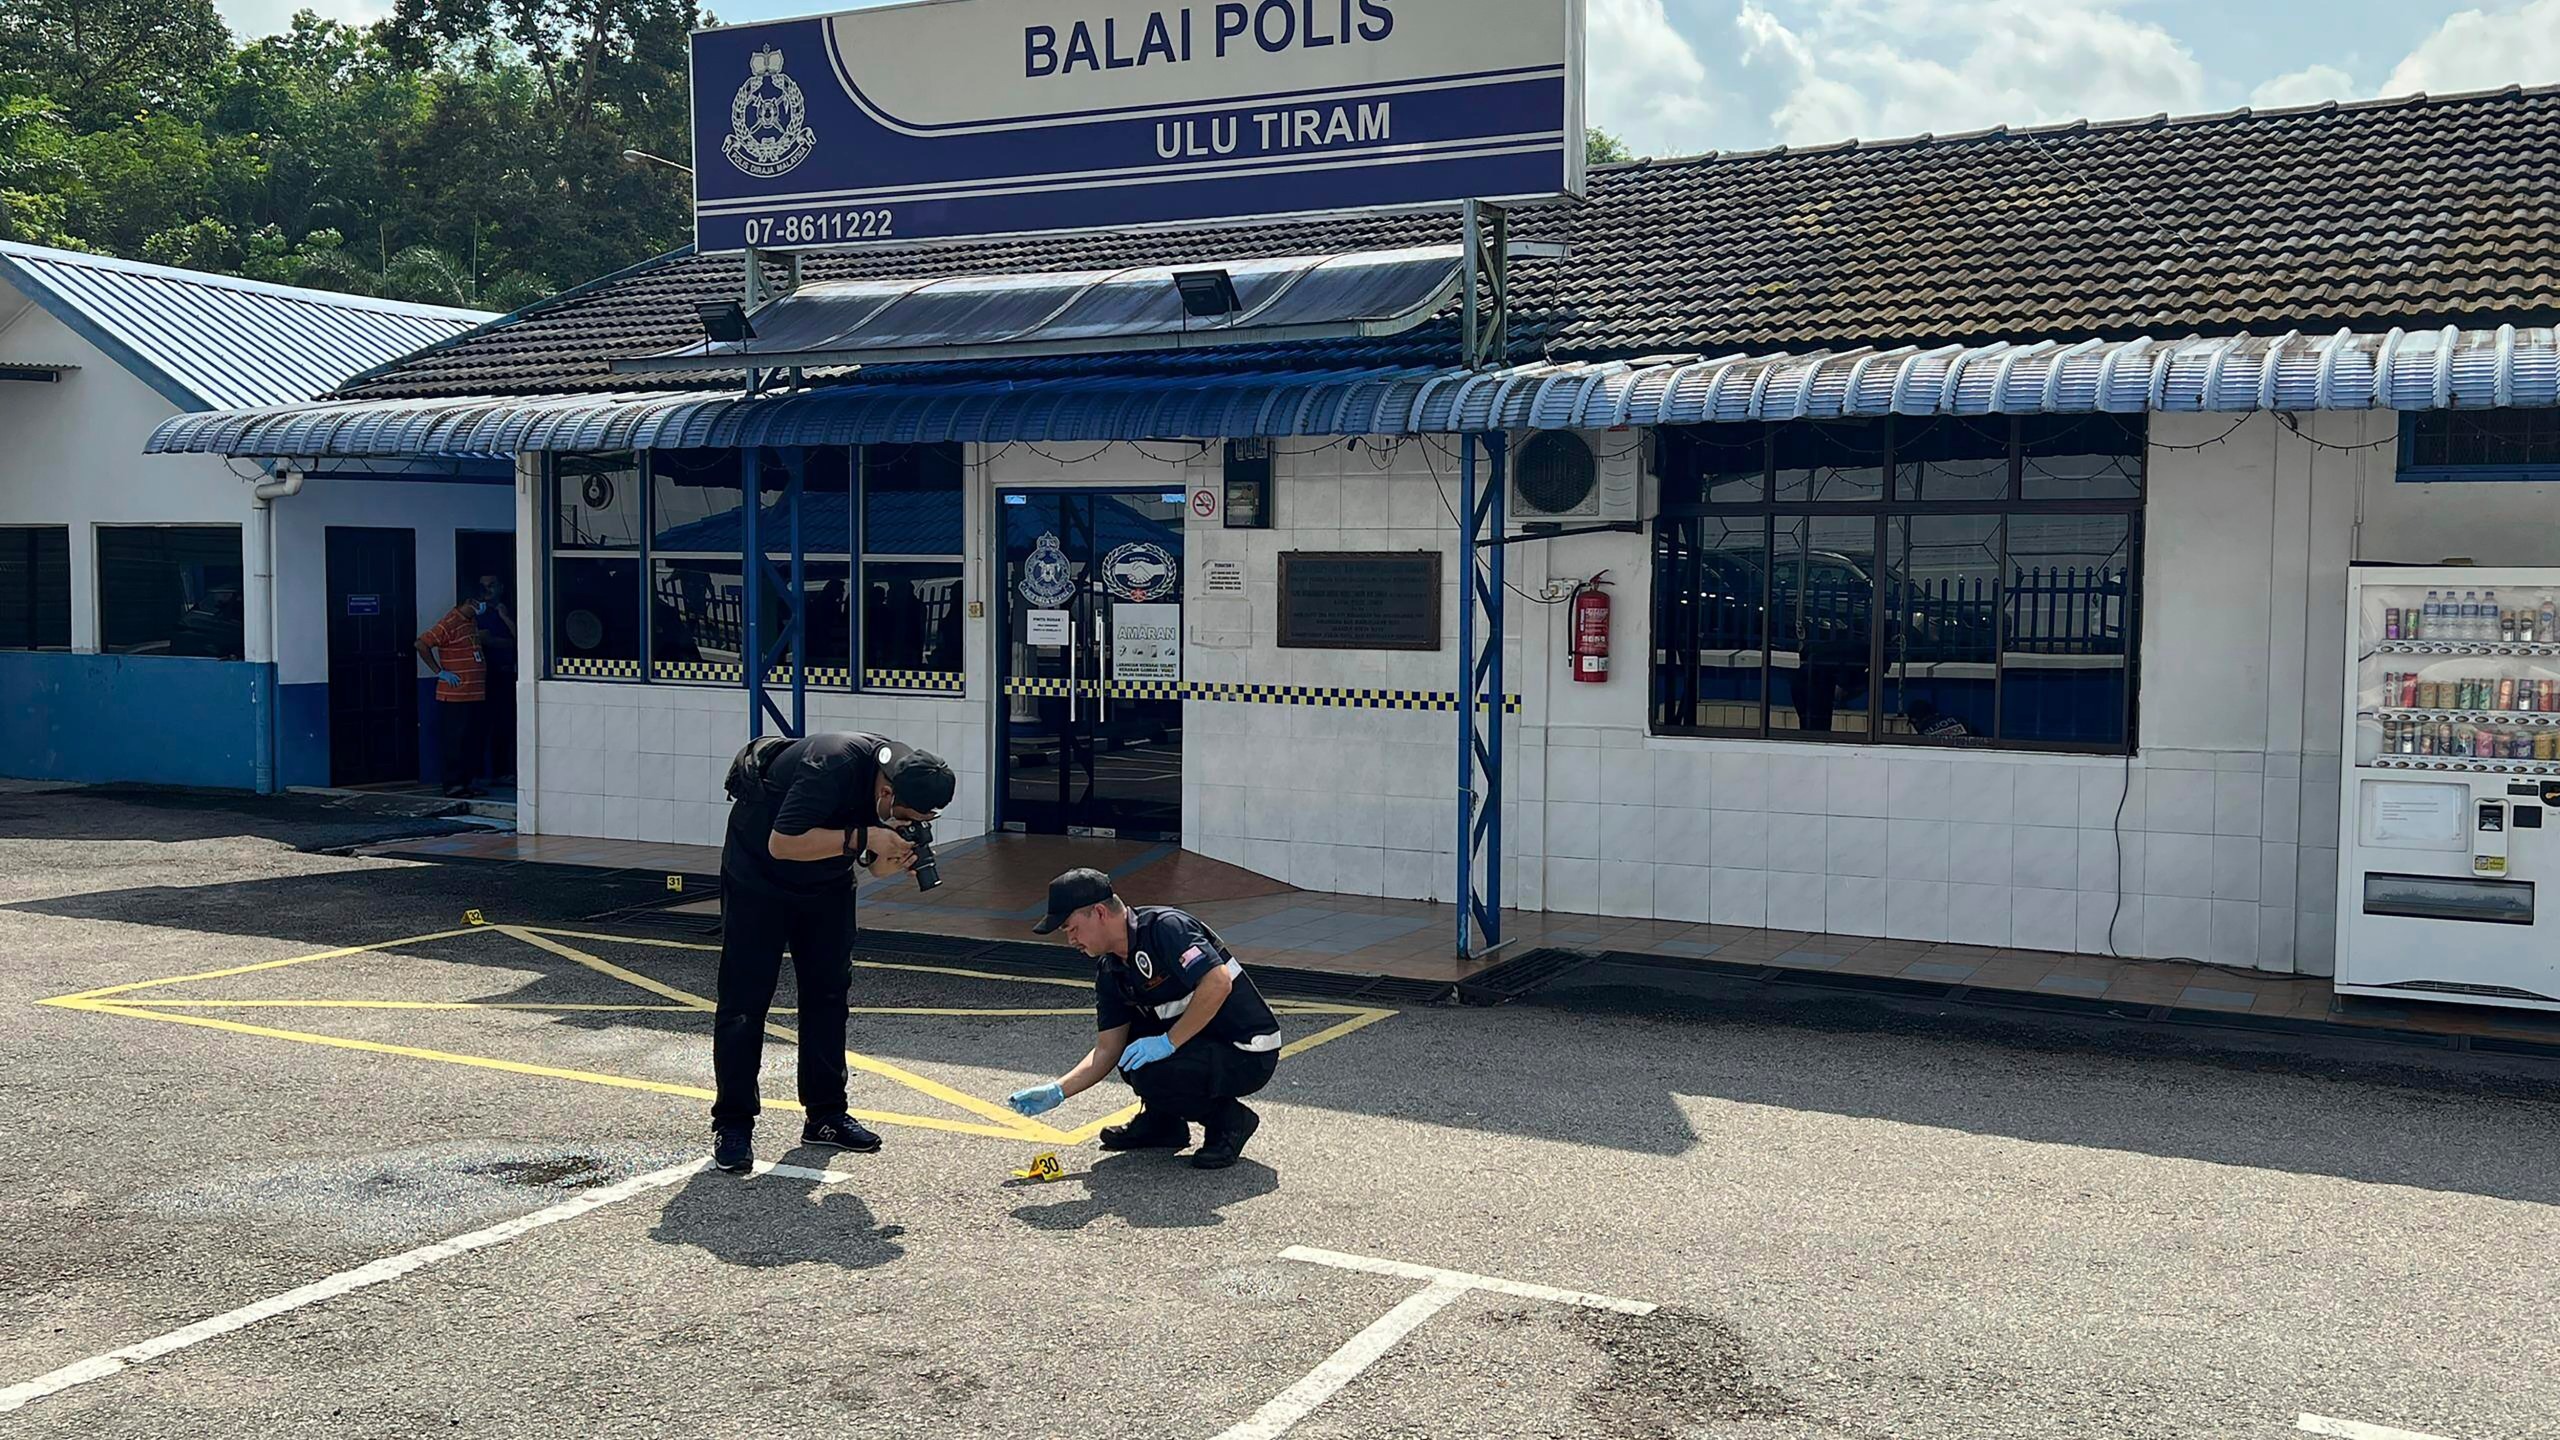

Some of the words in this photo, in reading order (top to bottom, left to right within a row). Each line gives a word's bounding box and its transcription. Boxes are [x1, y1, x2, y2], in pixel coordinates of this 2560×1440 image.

[1025, 8, 1191, 77] BALAI
[1215, 0, 1394, 57] POLIS
[1156, 116, 1238, 159] ULU
[1253, 102, 1390, 150] TIRAM
[730, 151, 750, 170] POLIS
[749, 166, 775, 175] DIRAJA
[776, 146, 808, 174] MALAYSIA
[745, 209, 893, 245] 07-8611222
[1117, 625, 1176, 641] AMARAN
[668, 877, 681, 887] 31
[469, 911, 482, 921] 32
[1039, 1156, 1060, 1175] 30
